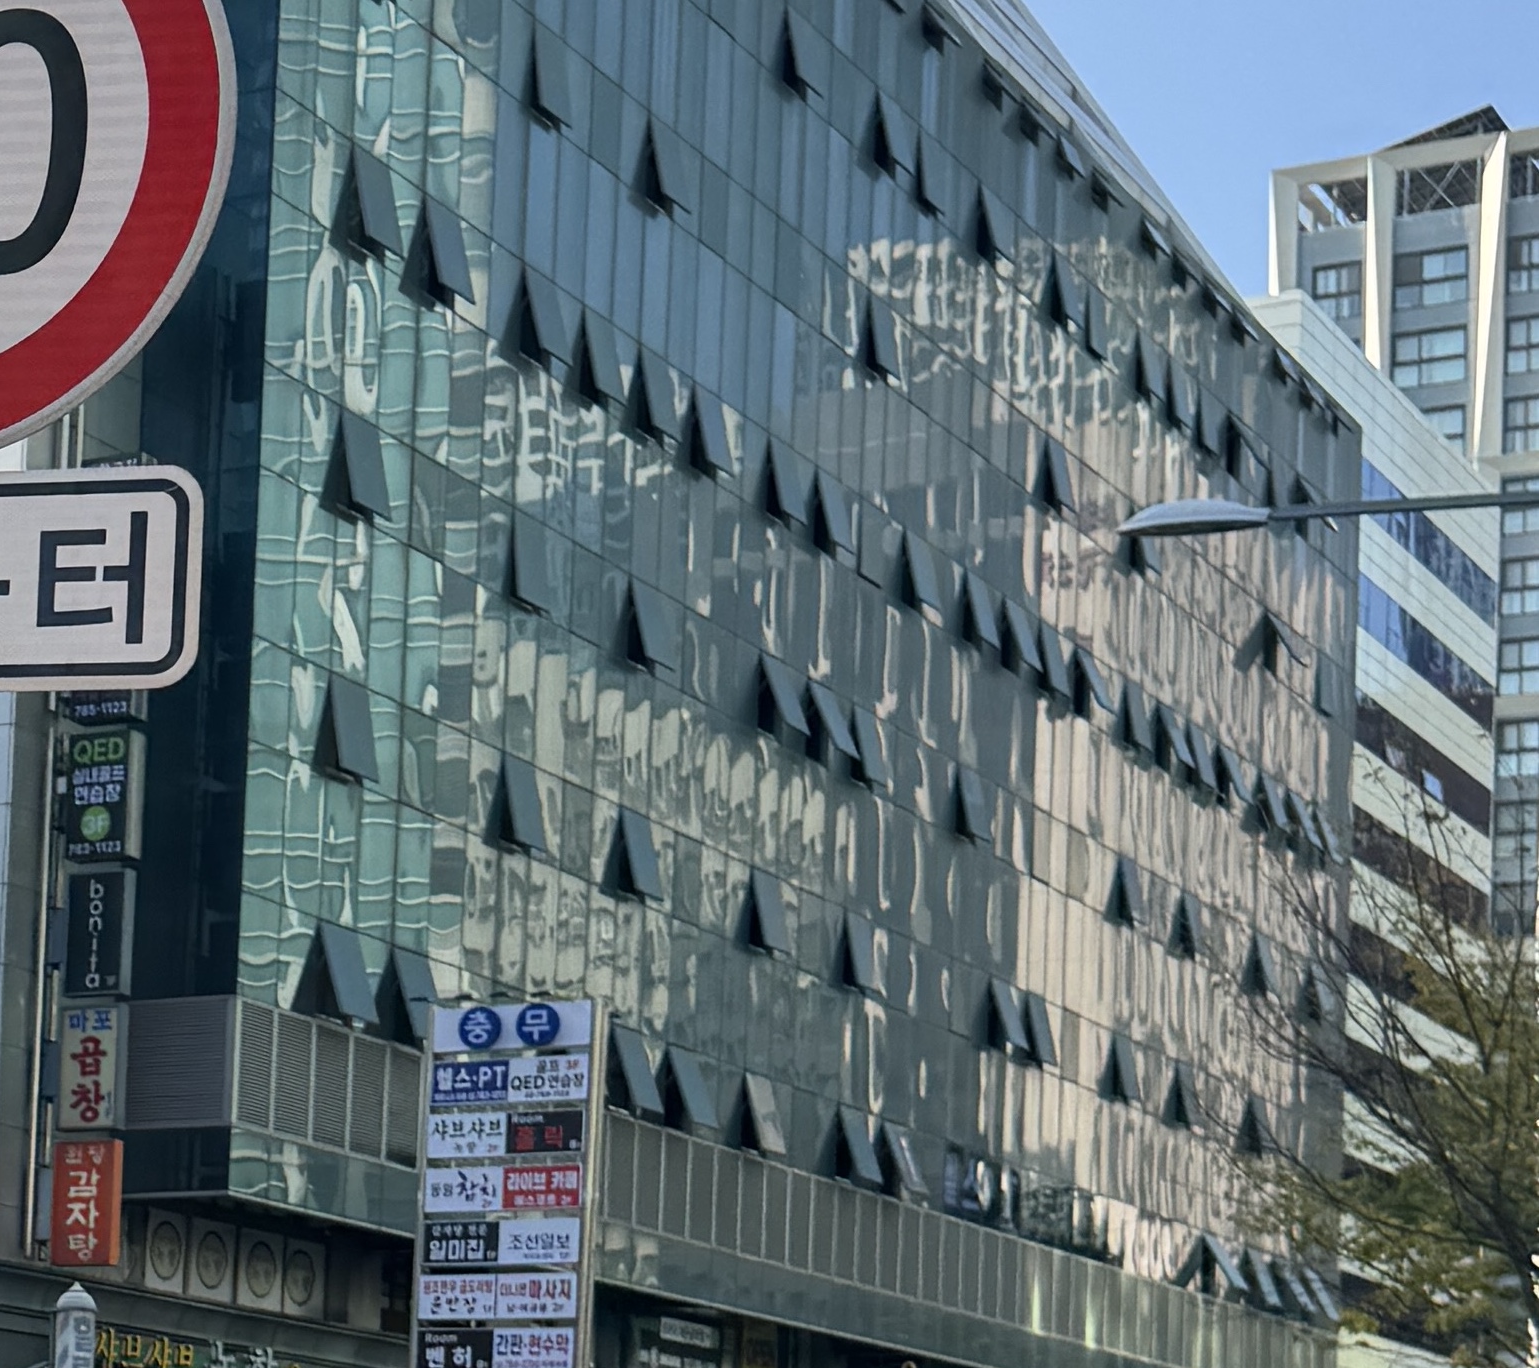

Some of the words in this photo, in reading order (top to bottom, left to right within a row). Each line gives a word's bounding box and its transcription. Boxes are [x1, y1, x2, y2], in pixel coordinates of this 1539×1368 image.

[74, 737, 125, 764] QED
[85, 879, 105, 989] bonita
[68, 1010, 112, 1032] 마포
[464, 1009, 551, 1043] 충무
[69, 1036, 108, 1123] 곱창
[510, 1075, 545, 1091] QED
[432, 1117, 503, 1141] 샤브샤브
[456, 1170, 496, 1203] 참치
[507, 1172, 546, 1191] 라이브
[66, 1169, 102, 1263] 감자탕
[507, 1233, 570, 1251] 조선일보
